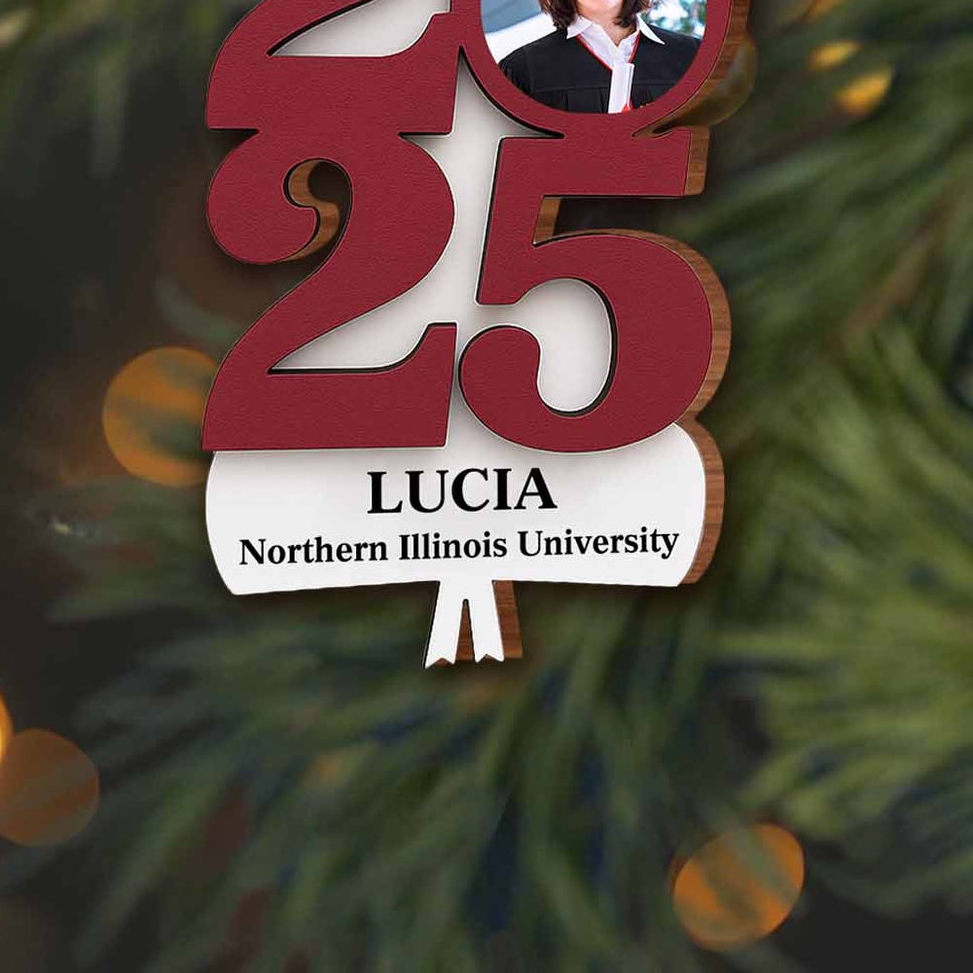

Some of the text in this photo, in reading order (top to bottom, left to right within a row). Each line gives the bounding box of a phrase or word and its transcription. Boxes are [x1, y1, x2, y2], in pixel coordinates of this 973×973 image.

[367, 468, 557, 513] LUCIA
[240, 527, 680, 565] Northern Illinois University
